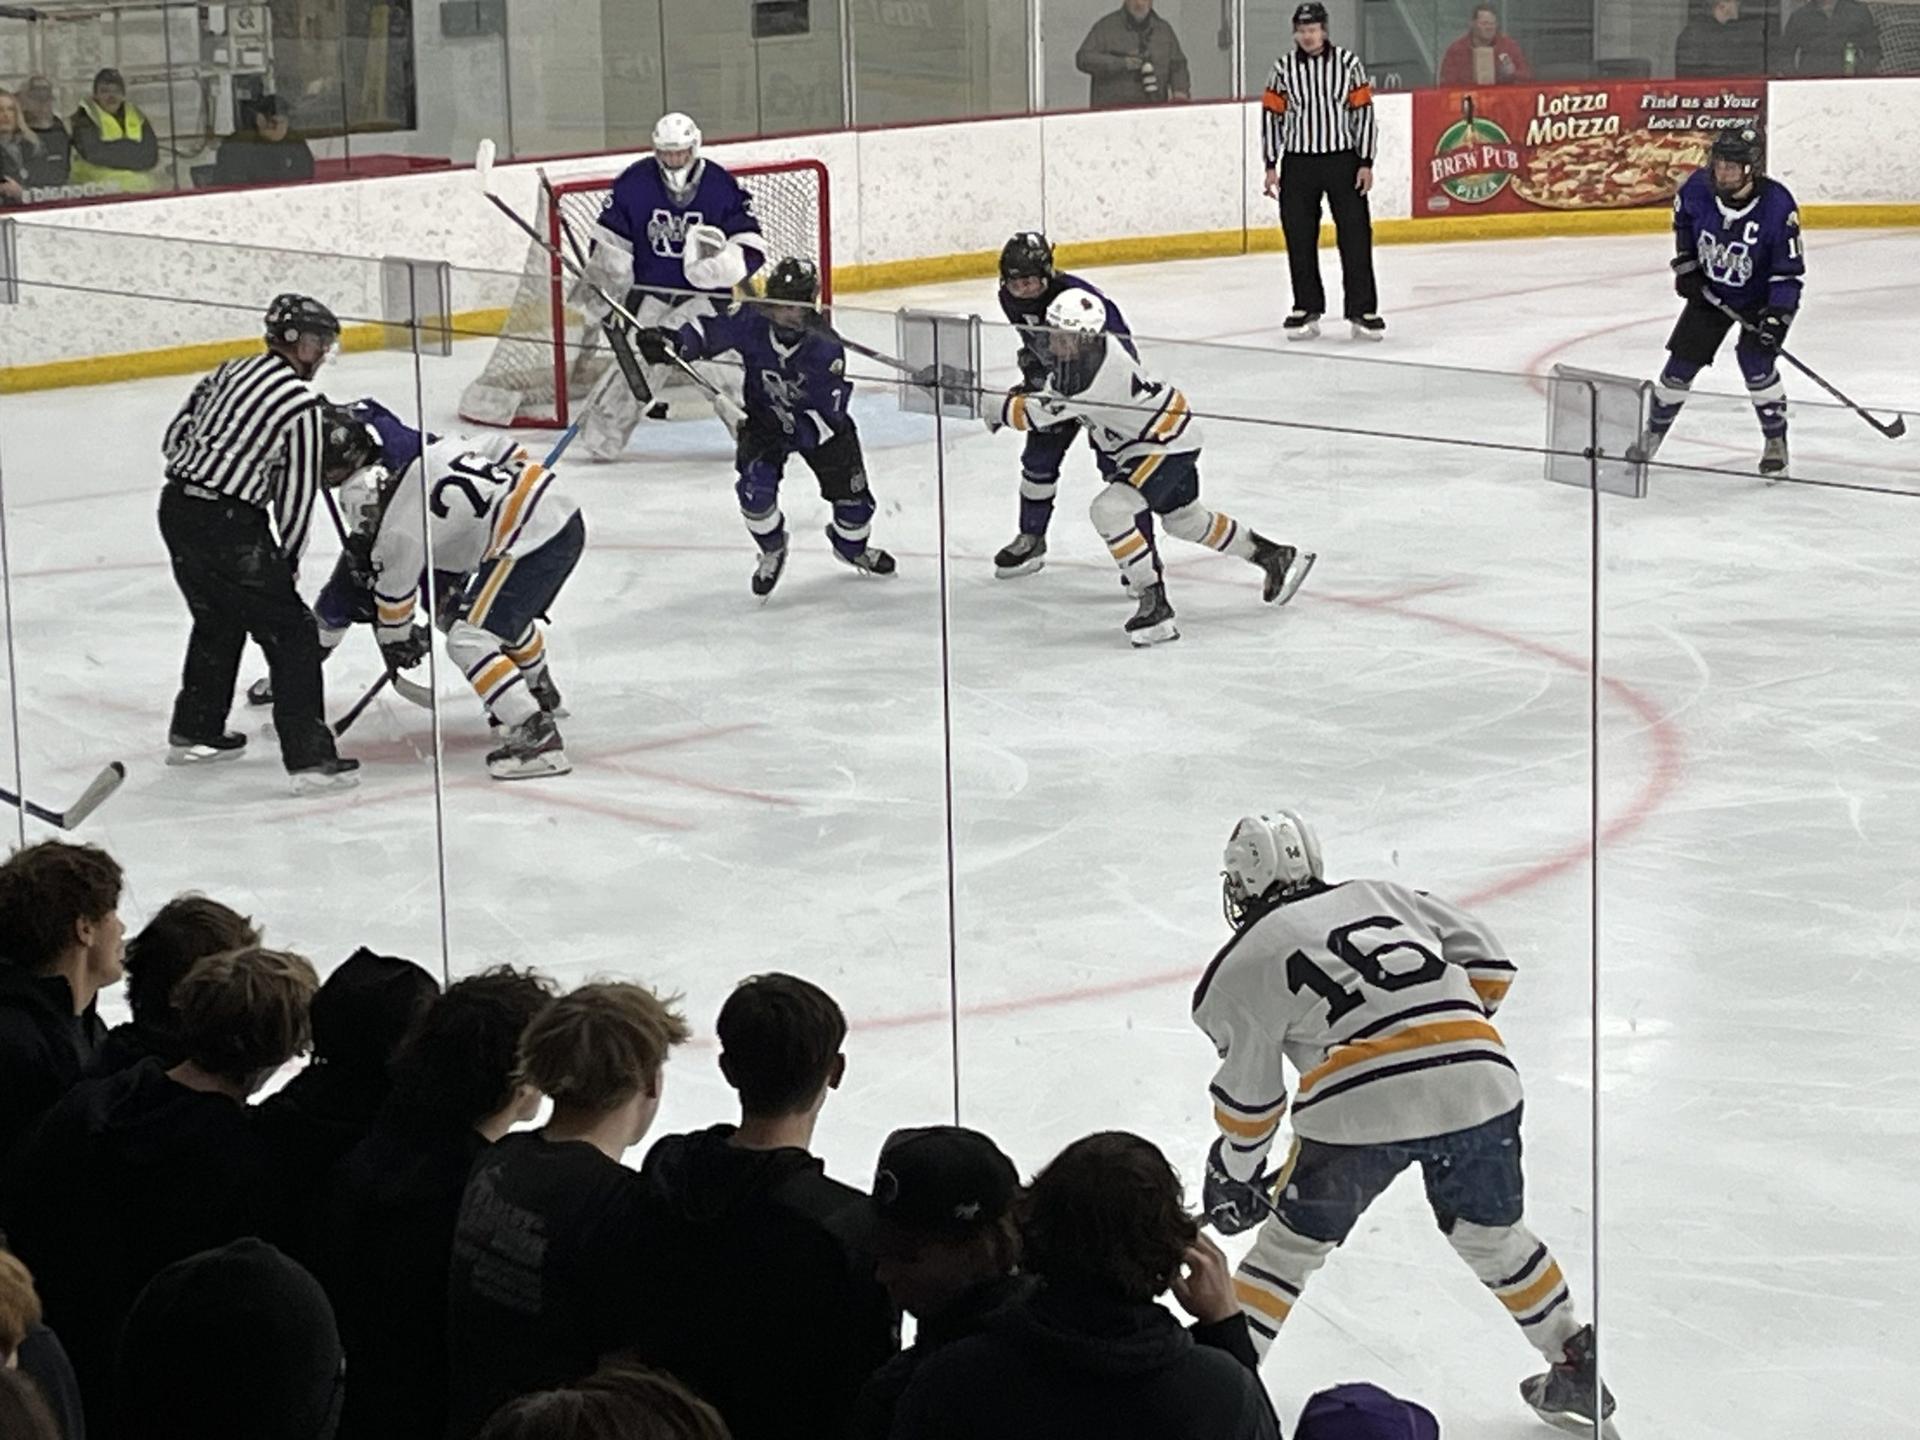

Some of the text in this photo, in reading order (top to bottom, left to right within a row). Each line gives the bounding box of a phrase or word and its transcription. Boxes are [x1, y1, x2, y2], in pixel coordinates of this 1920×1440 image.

[1537, 93, 1608, 117] Lotzza
[1641, 93, 1760, 109] Find us at Your
[1526, 115, 1620, 147] Motzza
[1648, 114, 1694, 130] Local
[1431, 145, 1519, 183] BREW PUB
[1456, 180, 1498, 200] PIZZA
[1743, 220, 1759, 245] C
[1286, 916, 1447, 1028] 16
